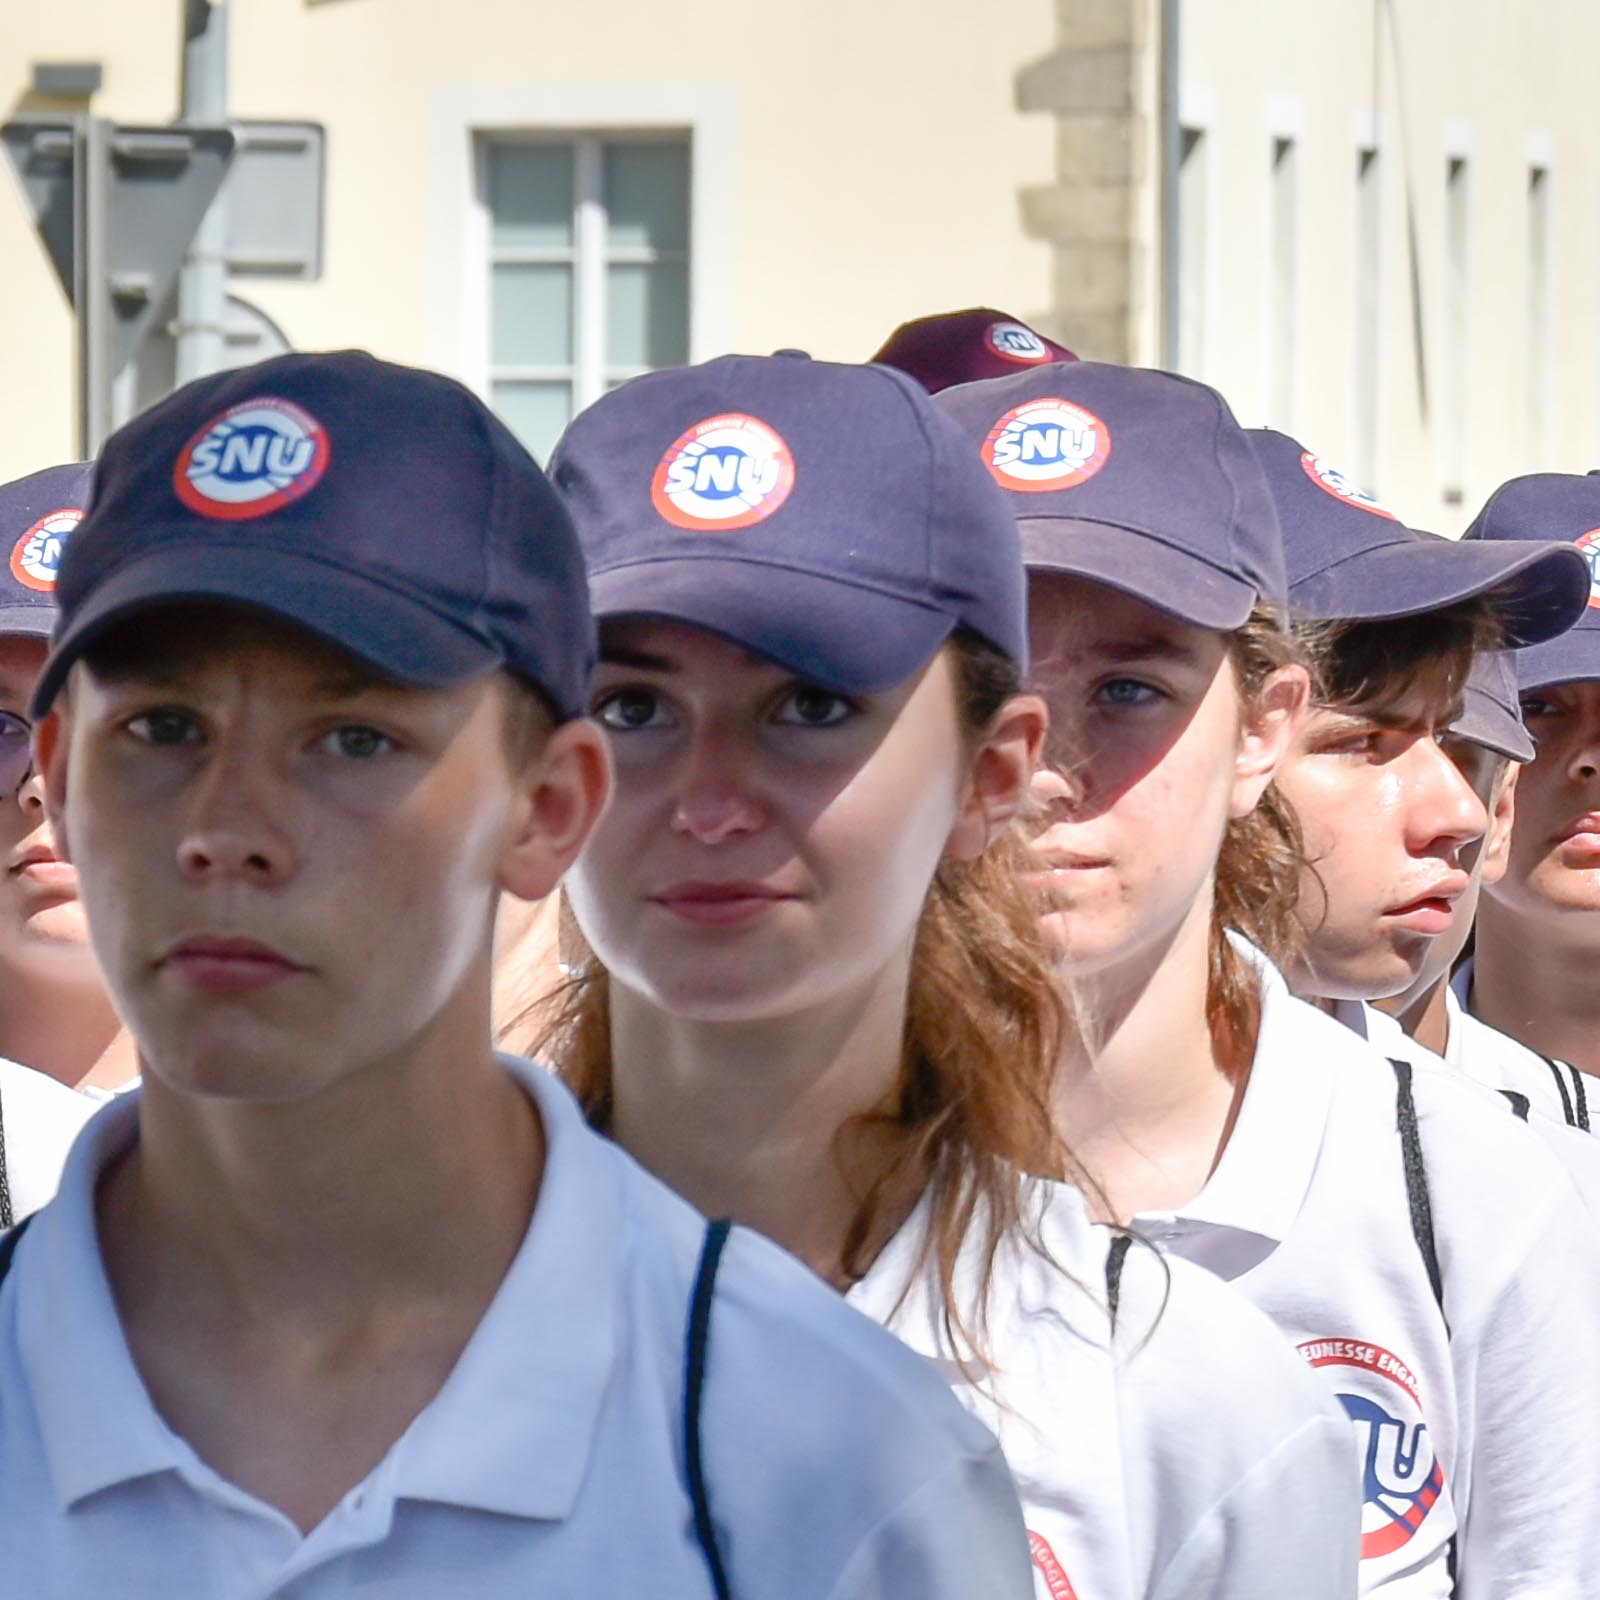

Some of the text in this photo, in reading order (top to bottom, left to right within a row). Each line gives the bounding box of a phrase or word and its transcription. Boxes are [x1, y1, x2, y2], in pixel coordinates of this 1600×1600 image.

[184, 432, 315, 478] SNU
[991, 428, 1097, 466] SNU
[663, 453, 780, 496] SNU
[1299, 1341, 1376, 1364] EUNESSE
